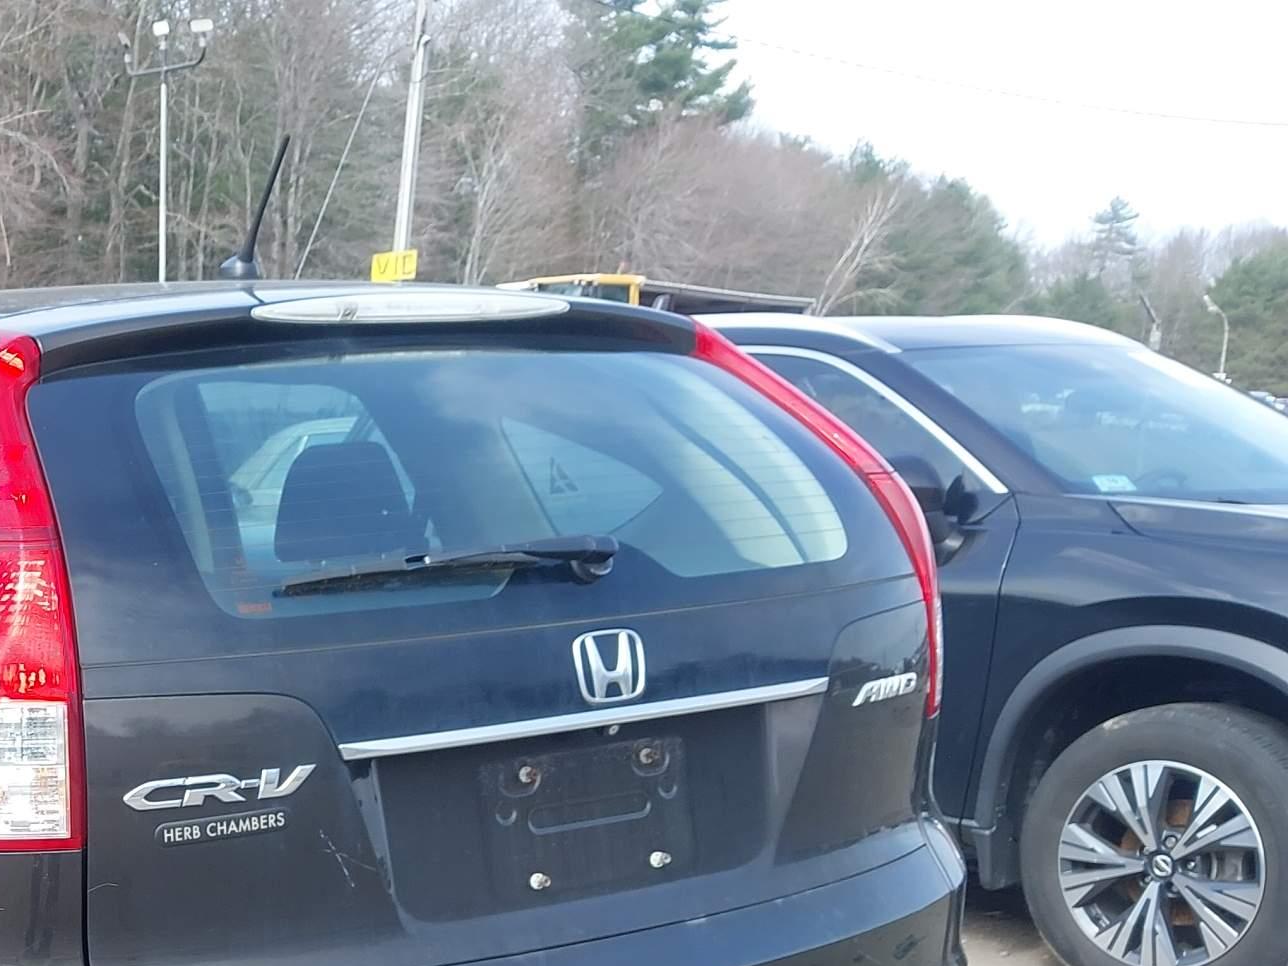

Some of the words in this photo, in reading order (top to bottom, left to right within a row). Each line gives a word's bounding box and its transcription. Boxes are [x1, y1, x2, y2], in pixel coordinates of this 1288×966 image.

[852, 671, 917, 707] AWD
[123, 763, 316, 811] CR-V
[163, 825, 201, 843] HERB
[206, 812, 285, 837] CHAMBERS
